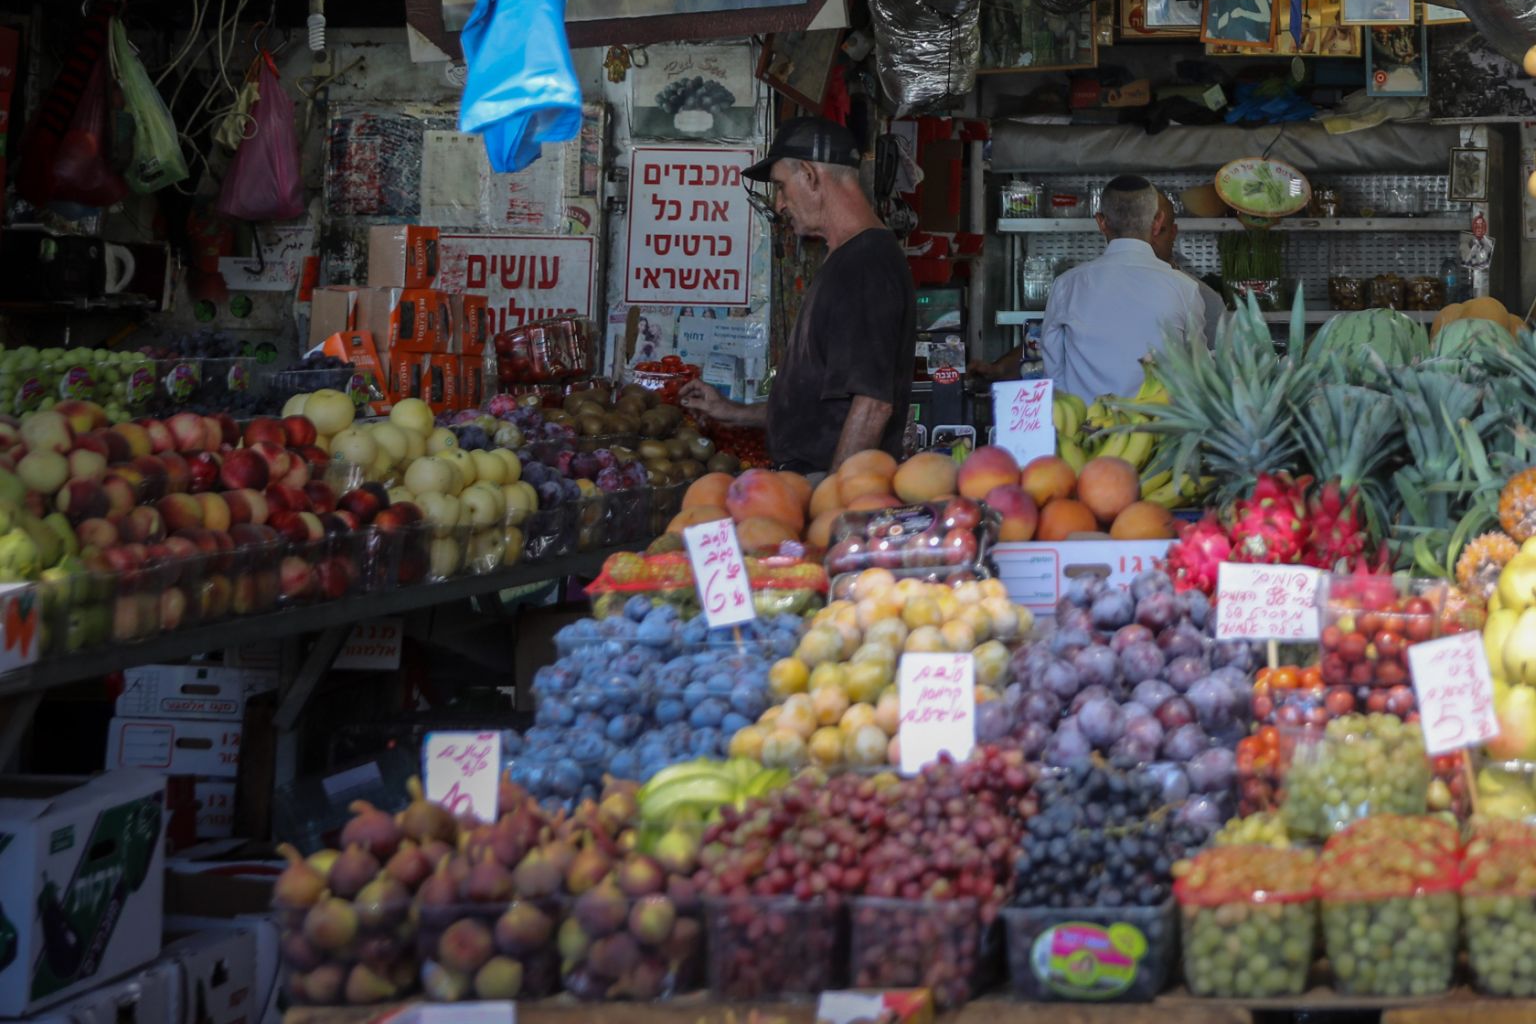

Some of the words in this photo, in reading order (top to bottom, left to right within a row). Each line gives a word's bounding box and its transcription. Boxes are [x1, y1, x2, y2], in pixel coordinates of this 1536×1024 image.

[643, 163, 741, 187] מכבדים
[651, 193, 682, 222] כל
[690, 200, 730, 222] את
[645, 234, 732, 257] כרטיסי
[466, 255, 560, 290] עושים
[635, 267, 740, 291] האשראי
[705, 569, 727, 613] 6
[352, 624, 396, 640] מנג
[1433, 702, 1464, 744] 5
